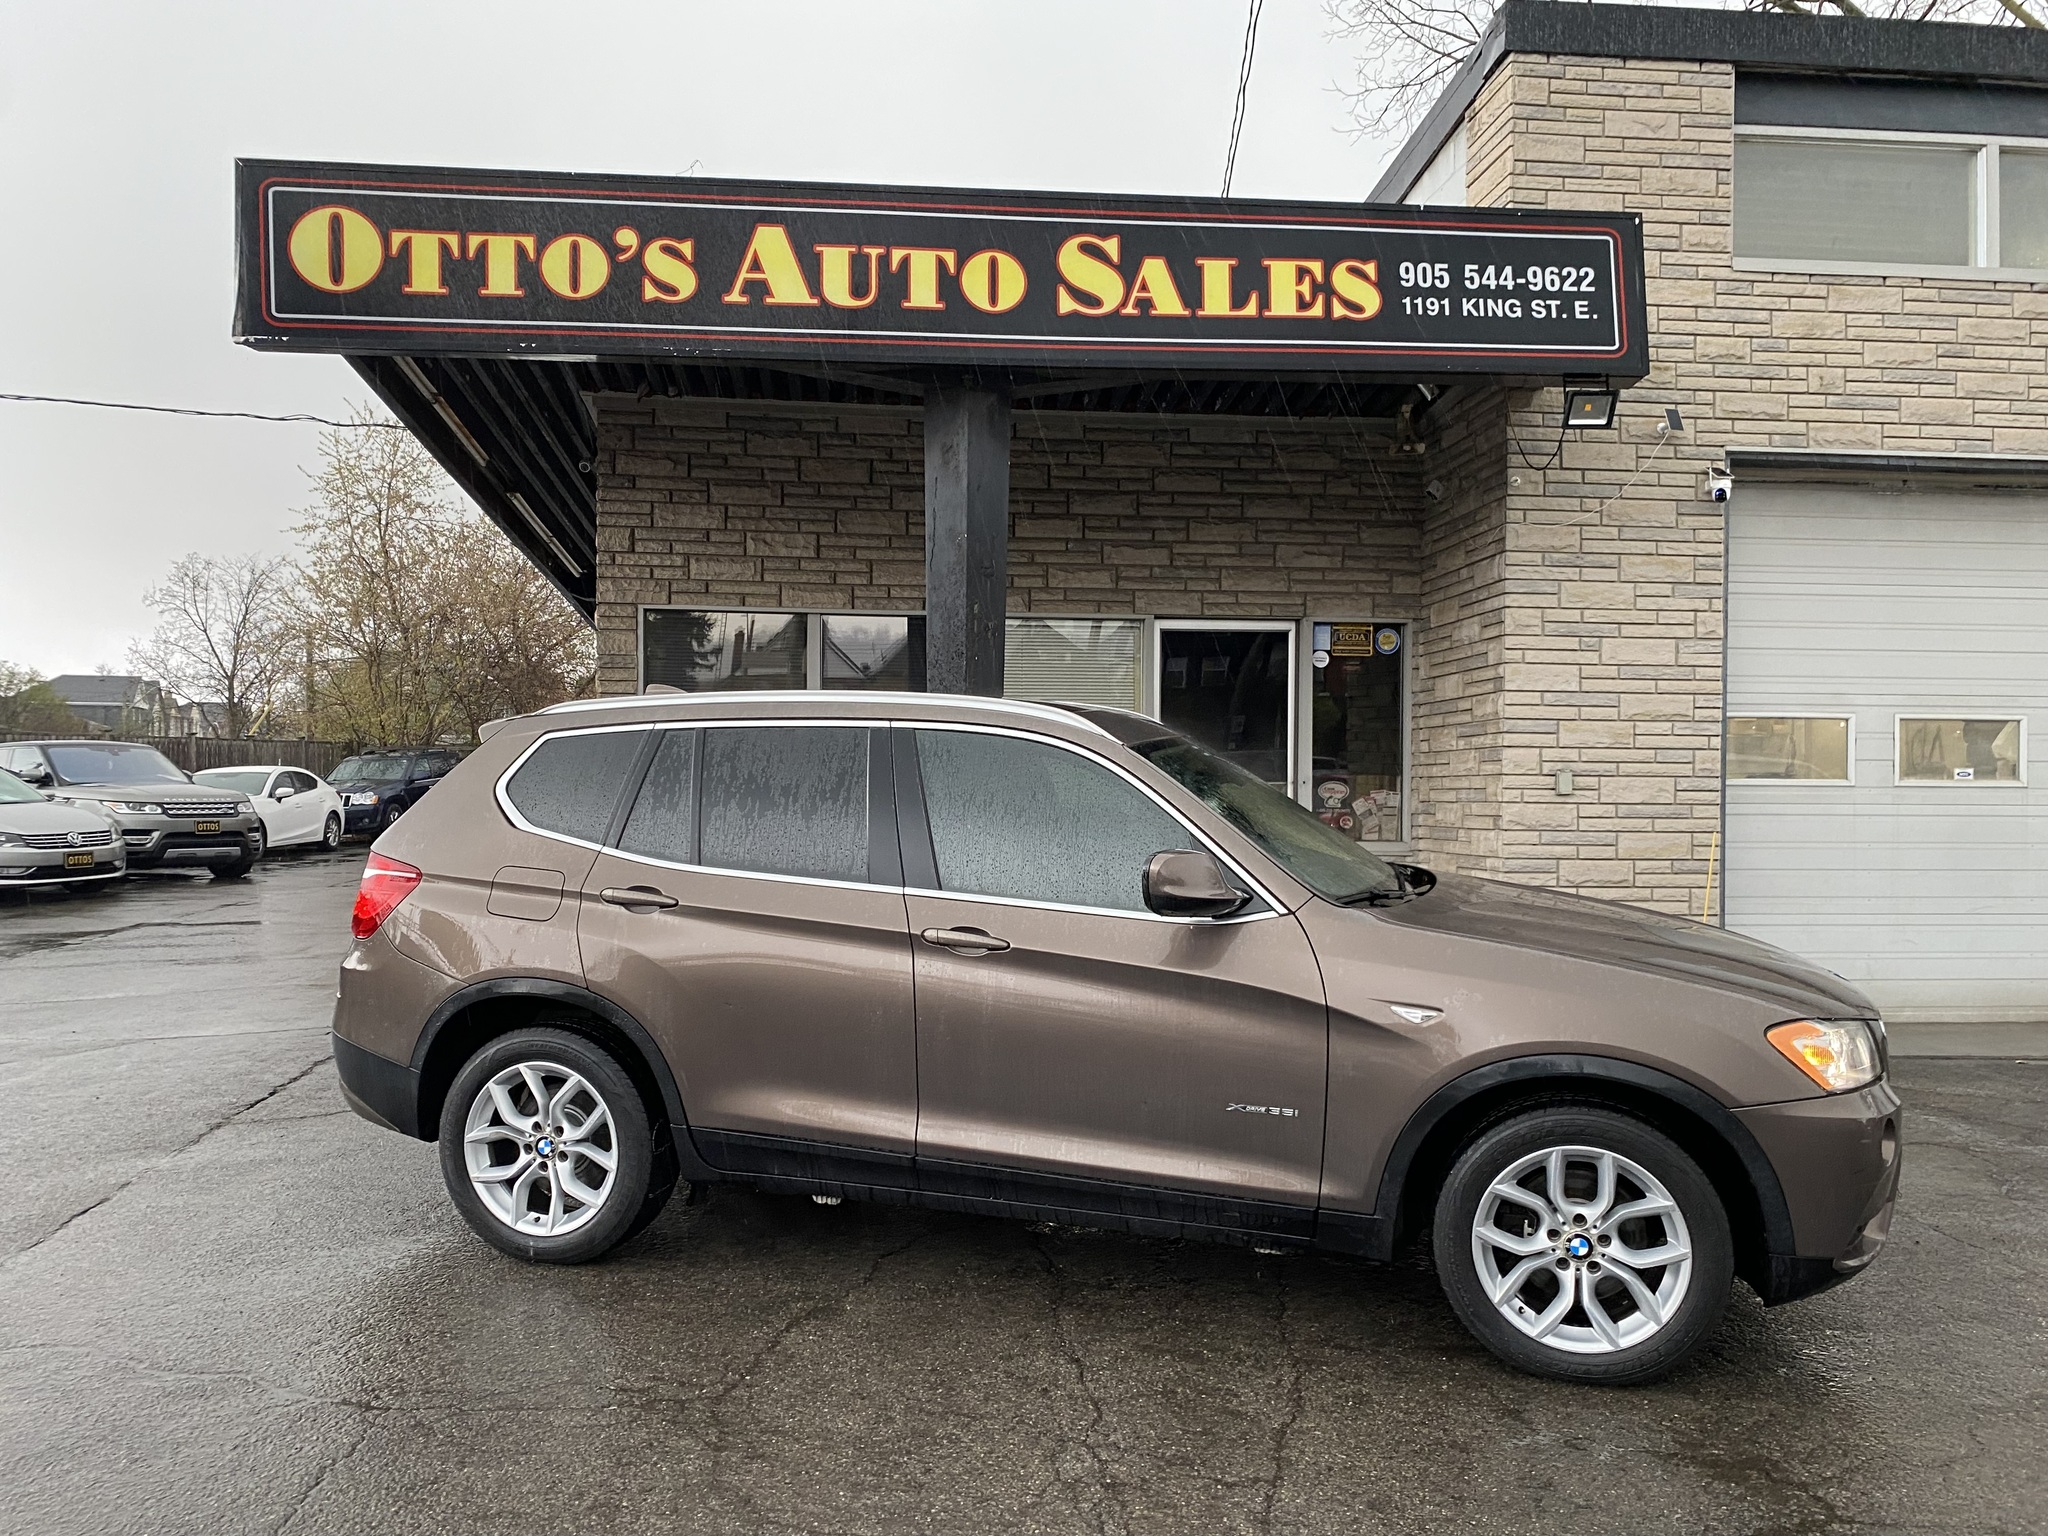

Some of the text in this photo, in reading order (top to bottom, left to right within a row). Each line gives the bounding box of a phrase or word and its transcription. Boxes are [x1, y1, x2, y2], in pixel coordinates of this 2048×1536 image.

[287, 204, 1383, 321] OTTO'S AUTO SALES
[1399, 261, 1596, 292] 905 544-9622
[1401, 296, 1598, 320] 1191 KING ST. E.
[1339, 633, 1366, 641] UCDA
[197, 823, 219, 831] OTTOS
[68, 855, 92, 866] OTTOS
